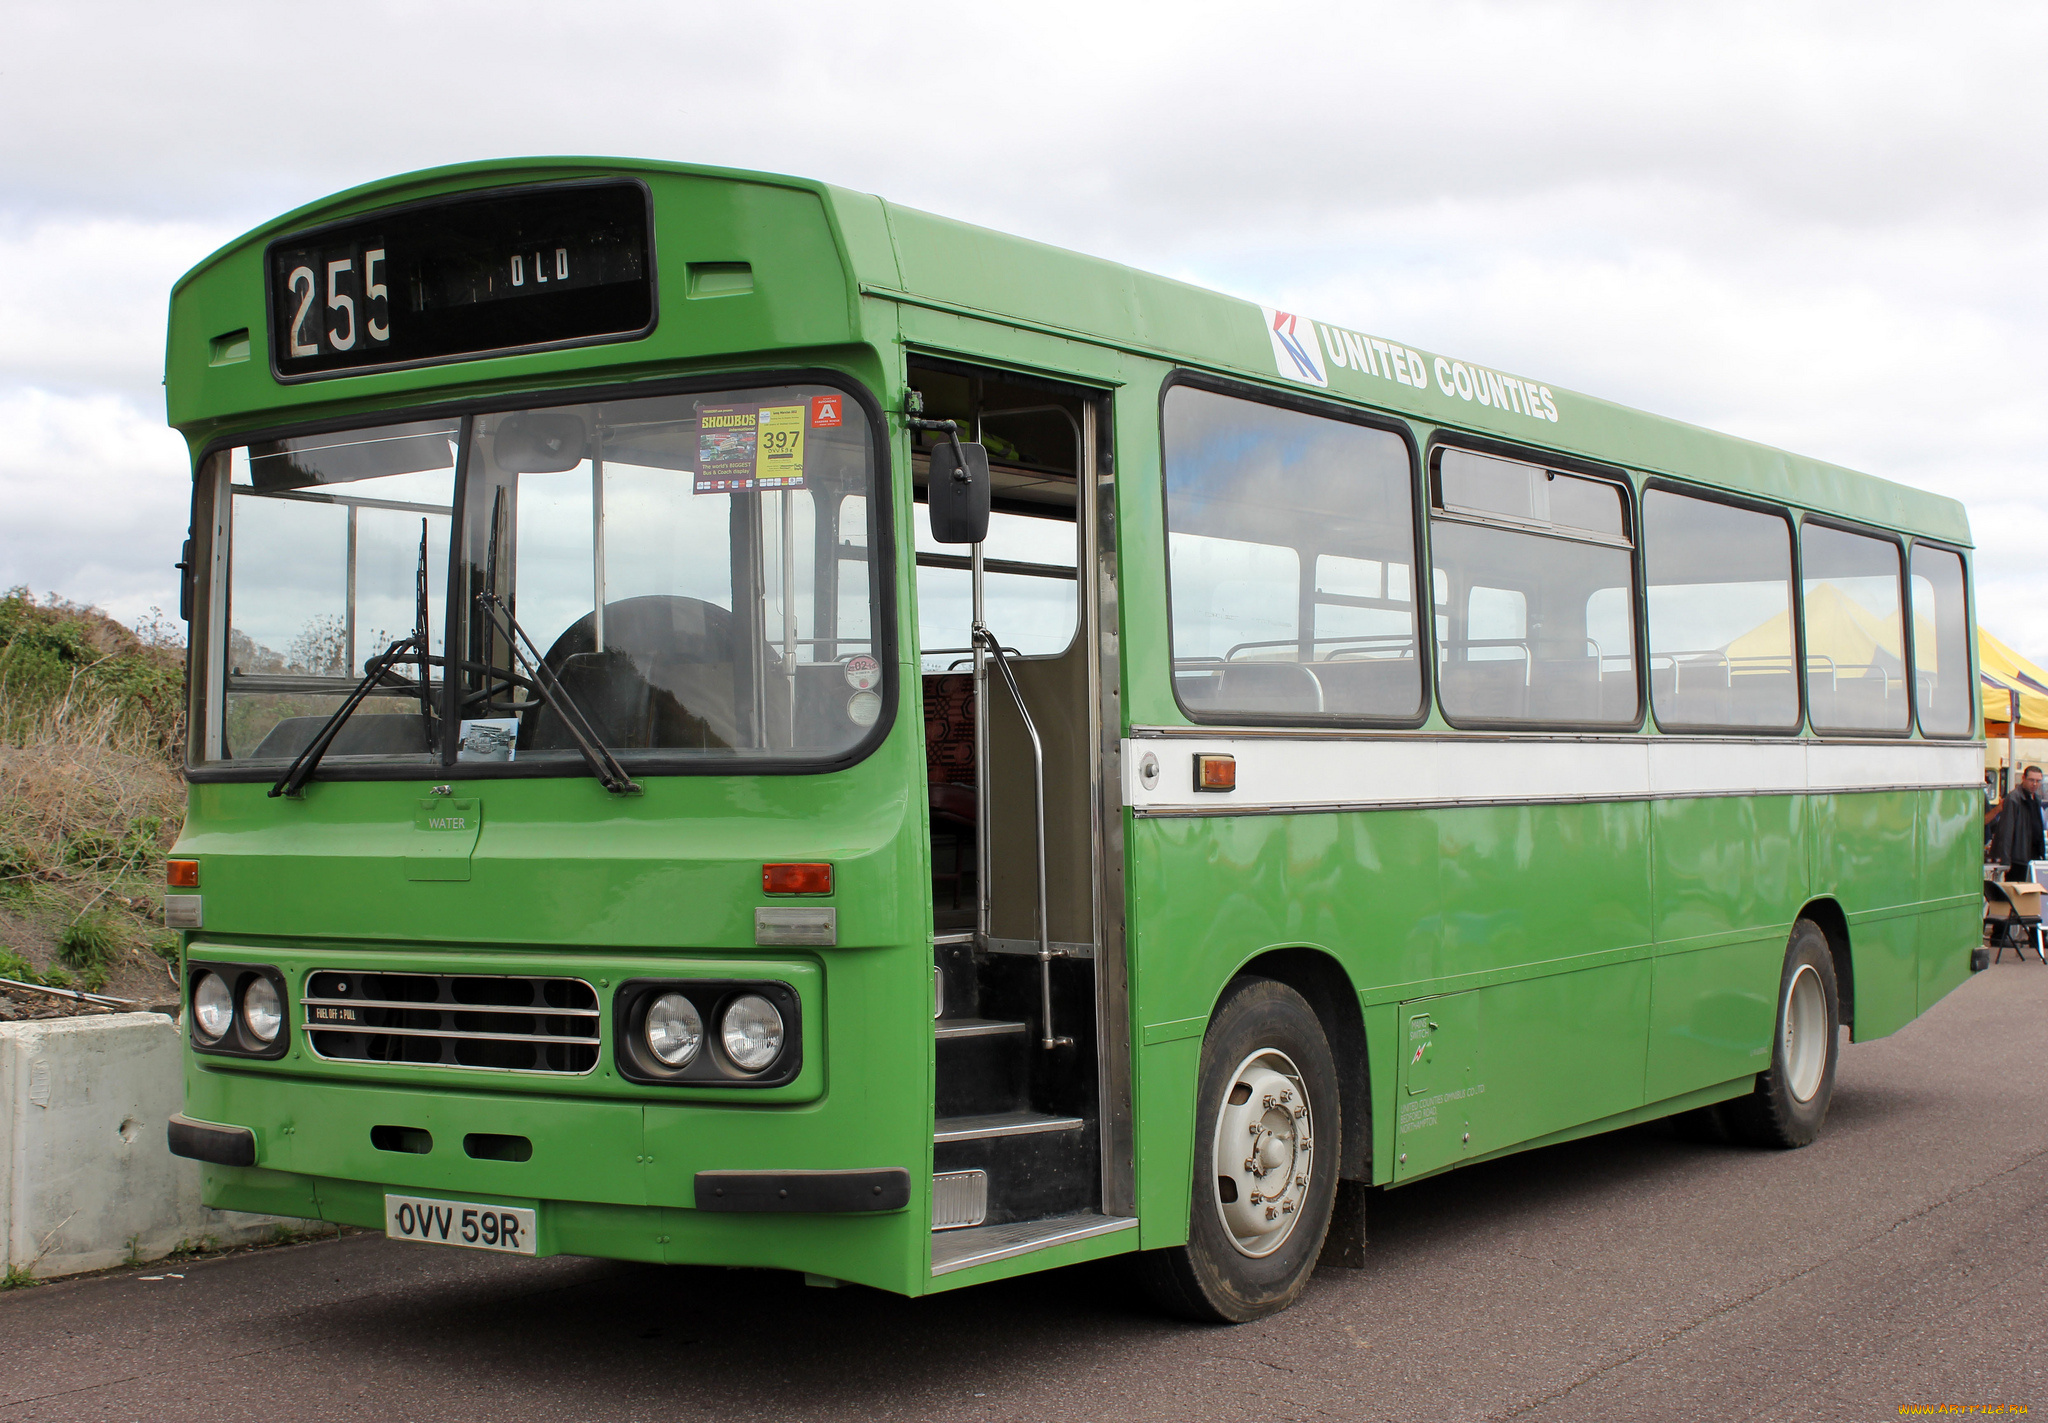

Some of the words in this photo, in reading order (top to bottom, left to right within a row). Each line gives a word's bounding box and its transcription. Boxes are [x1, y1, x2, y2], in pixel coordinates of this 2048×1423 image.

[510, 248, 568, 287] OLD
[288, 249, 389, 358] 255
[1320, 324, 1427, 390] UNITED
[1434, 357, 1559, 423] COUNTIES
[818, 403, 837, 420] A
[702, 414, 756, 429] SHOWBUS
[763, 430, 800, 449] 397
[855, 661, 867, 671] 02
[428, 817, 465, 829] WATER
[316, 1007, 328, 1019] FUEL
[328, 1008, 338, 1020] OFF
[343, 1009, 356, 1020] PULL
[1411, 1018, 1427, 1030] MAINS
[1410, 1029, 1431, 1040] SWITCH
[1400, 1101, 1418, 1115] UNITED
[1419, 1095, 1443, 1109] COUNTIES
[1444, 1089, 1466, 1103] OMNIBUS
[1400, 1110, 1422, 1124] BEDFORD
[399, 1202, 453, 1240] OVV
[461, 1209, 520, 1248] 59R
